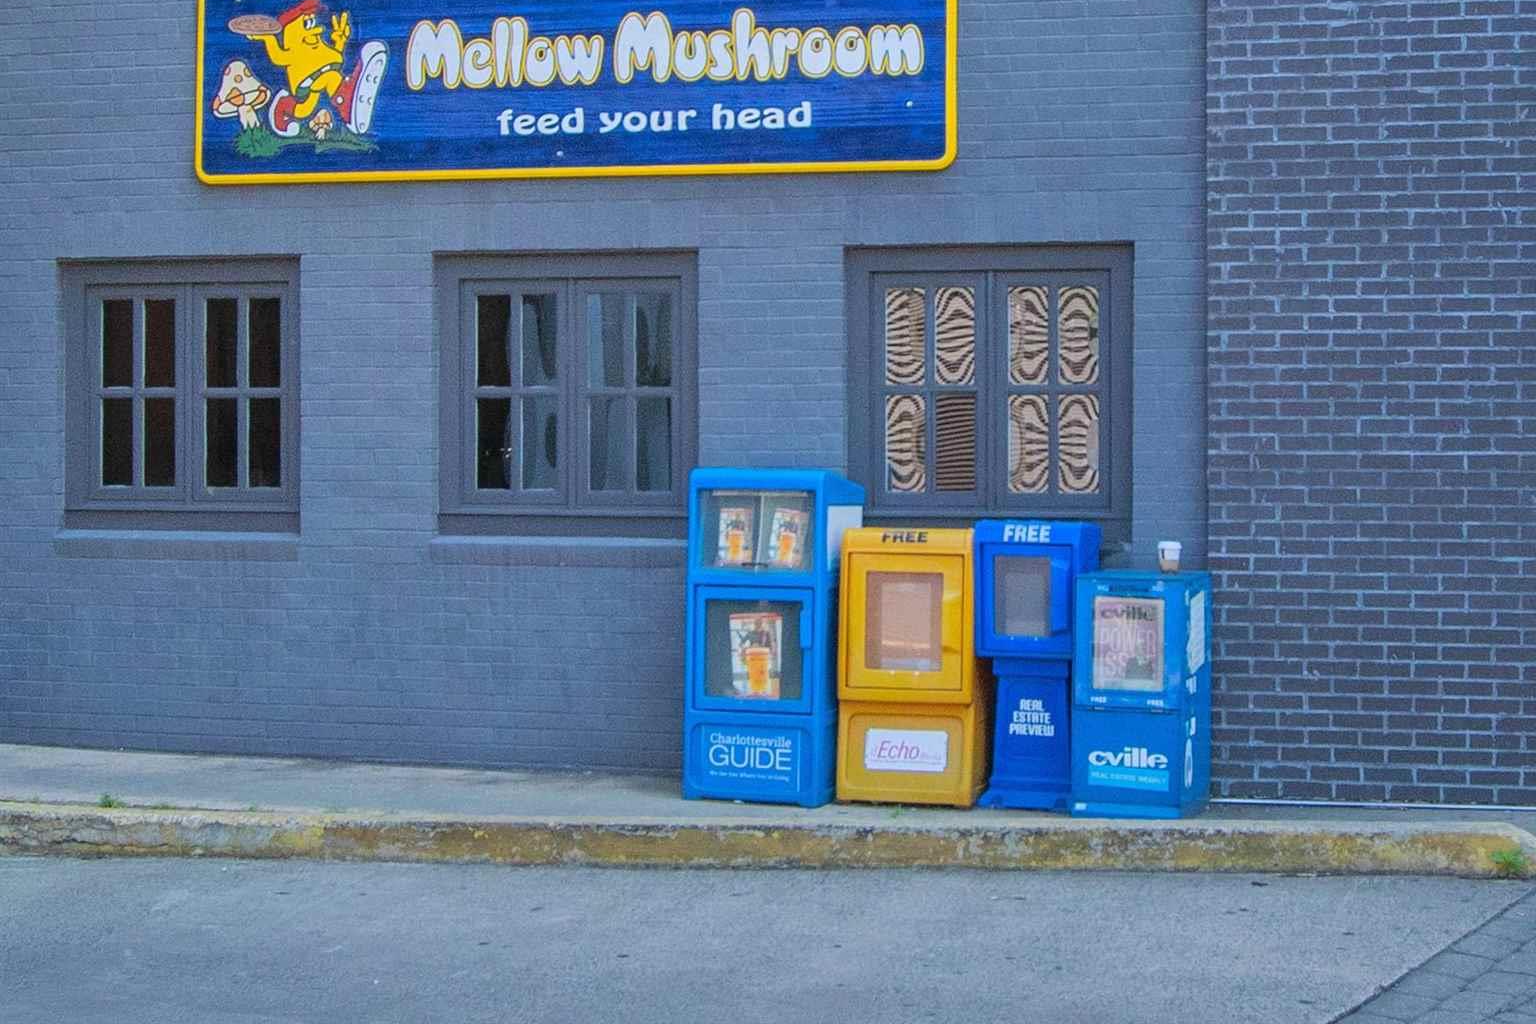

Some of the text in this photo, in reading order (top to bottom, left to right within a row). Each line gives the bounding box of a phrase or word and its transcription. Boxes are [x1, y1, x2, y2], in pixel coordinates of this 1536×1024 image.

[407, 7, 925, 89] Mellow Mushroom
[497, 101, 813, 136] feed your head
[882, 531, 929, 544] FREE
[1003, 524, 1052, 543] FREE
[1020, 699, 1044, 711] REAL
[1013, 711, 1051, 724] ESTATE
[1009, 723, 1055, 736] PREVIEW
[710, 732, 792, 748] Charlottesville
[877, 739, 920, 760] Echo
[708, 744, 792, 770] GUIDE
[1088, 747, 1168, 769] cville
